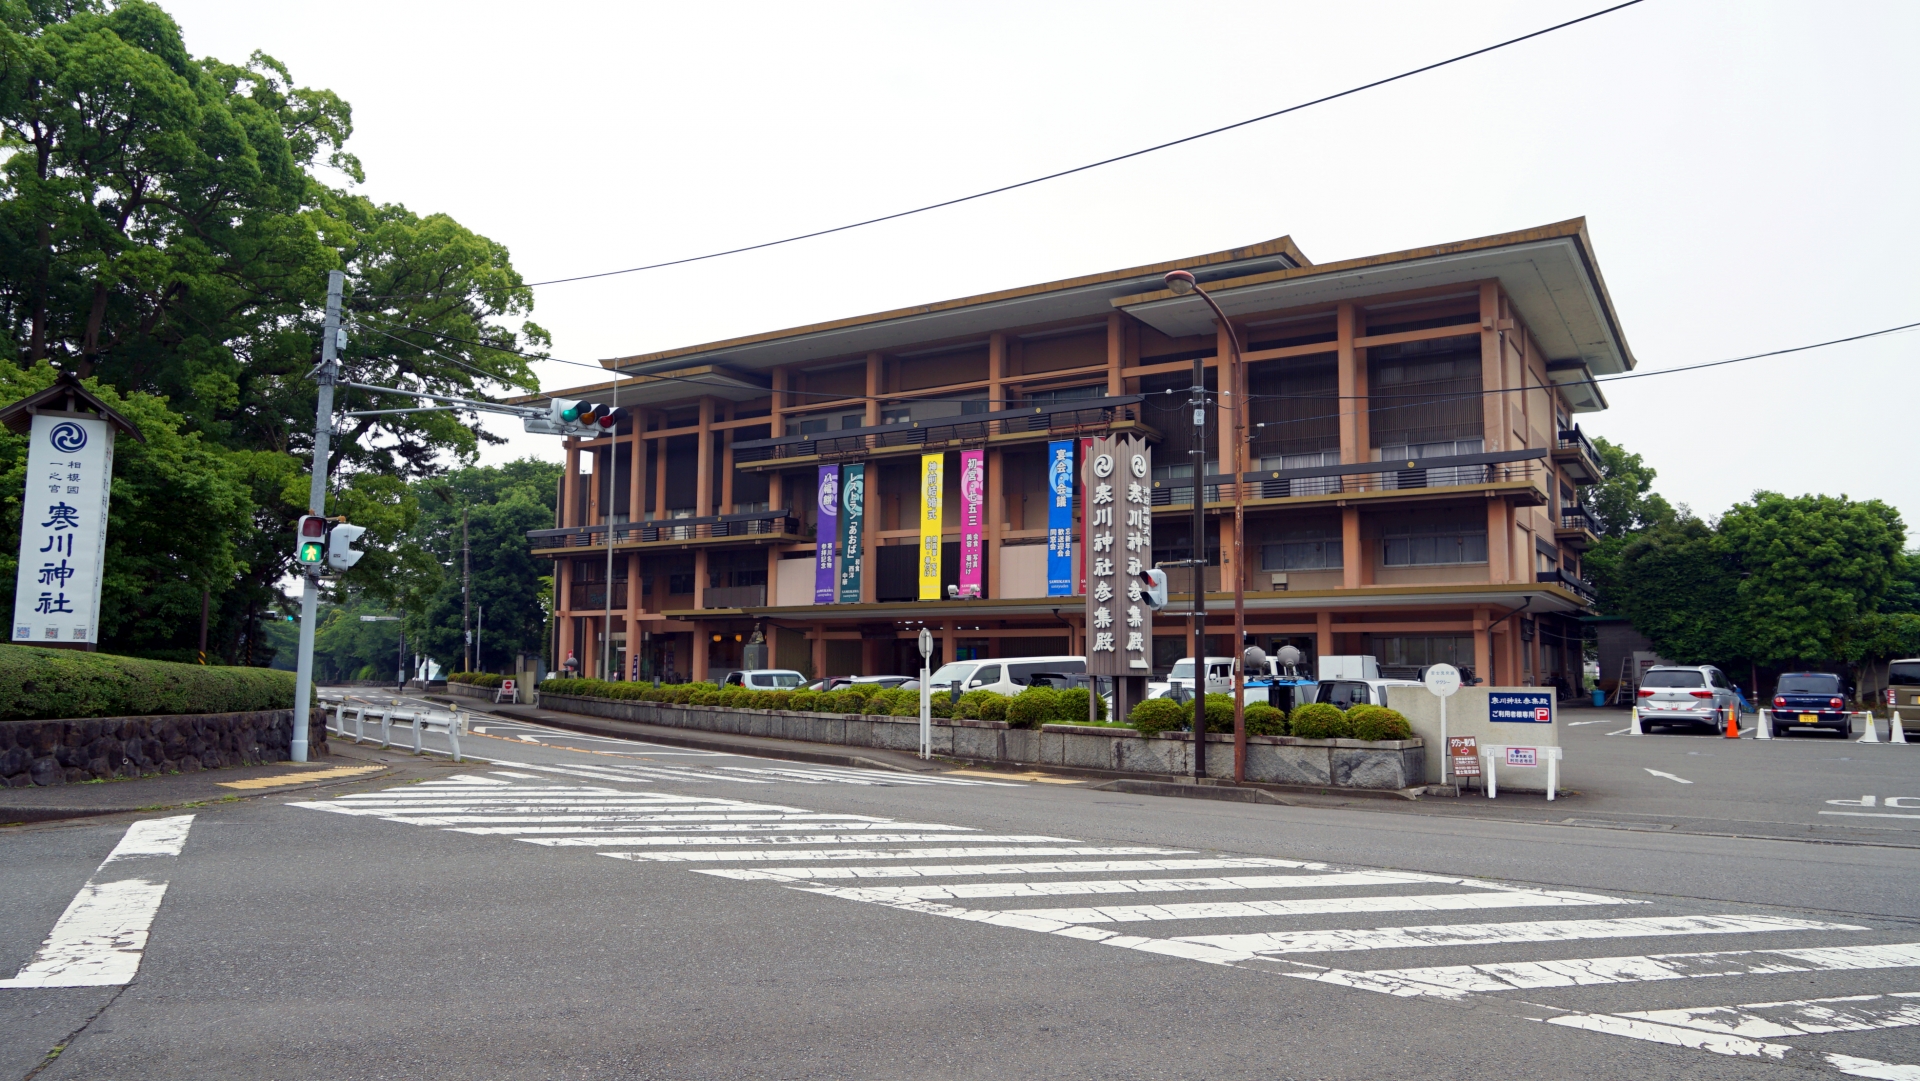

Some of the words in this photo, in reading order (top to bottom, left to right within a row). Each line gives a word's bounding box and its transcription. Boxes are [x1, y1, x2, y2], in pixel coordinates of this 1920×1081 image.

[49, 462, 63, 493] 一之宮
[846, 473, 858, 558] レストラン「あおば」
[927, 461, 937, 520] 神前結婚式
[968, 458, 977, 526] 初宮・七五三
[1056, 449, 1067, 507] 宴会・会議
[34, 501, 79, 615] 寒川神社
[1093, 482, 1115, 652] 寒川神社参集殿
[1126, 481, 1144, 652] 寒川神社参集殿
